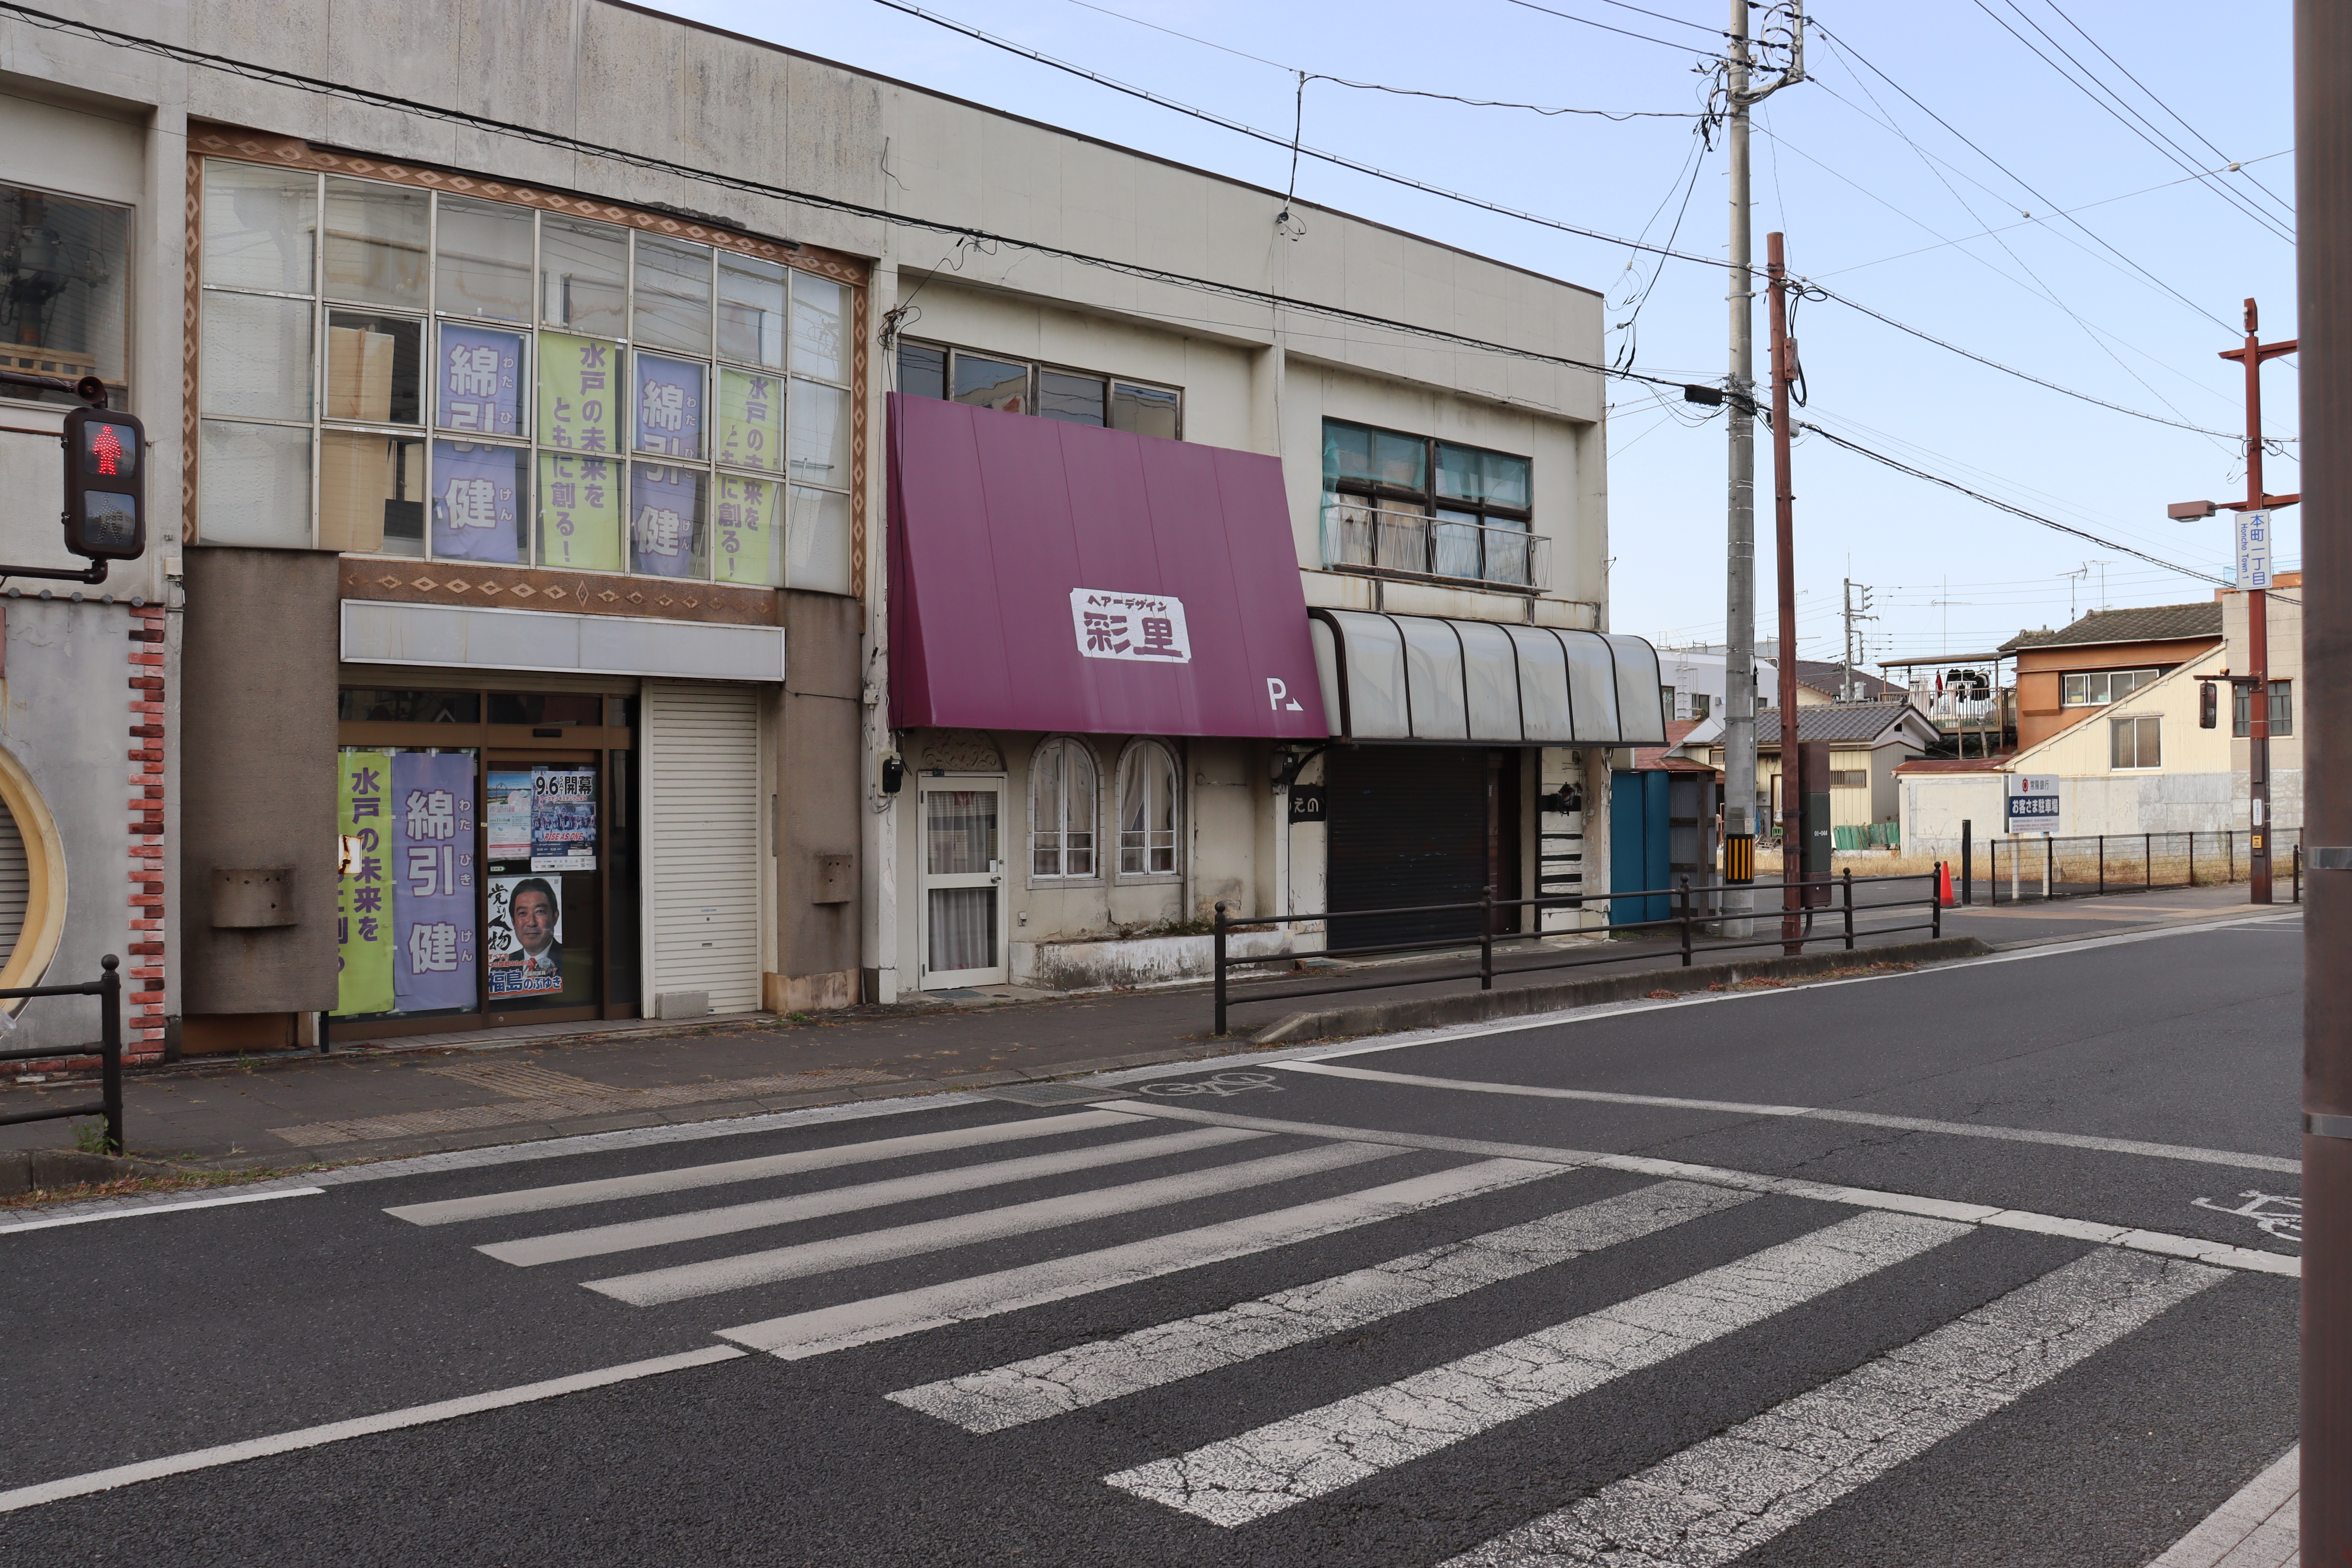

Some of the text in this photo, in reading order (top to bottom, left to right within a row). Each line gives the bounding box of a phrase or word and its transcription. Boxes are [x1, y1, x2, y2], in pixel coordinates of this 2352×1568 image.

[580, 343, 607, 508] 水戸の未来を
[2250, 514, 2265, 585] 本町一丁目
[1088, 595, 1167, 612] ヘアーデザイン
[1083, 611, 1183, 658] 彩里
[1267, 677, 1287, 710] P
[536, 776, 559, 795] 9.6
[565, 776, 592, 795] 開幕
[2030, 780, 2049, 790] 常陽銀行
[2012, 799, 2058, 814] お客さま駐車場
[352, 767, 382, 942] 水戸の未来を
[488, 971, 562, 993] 福島のぶゆき
